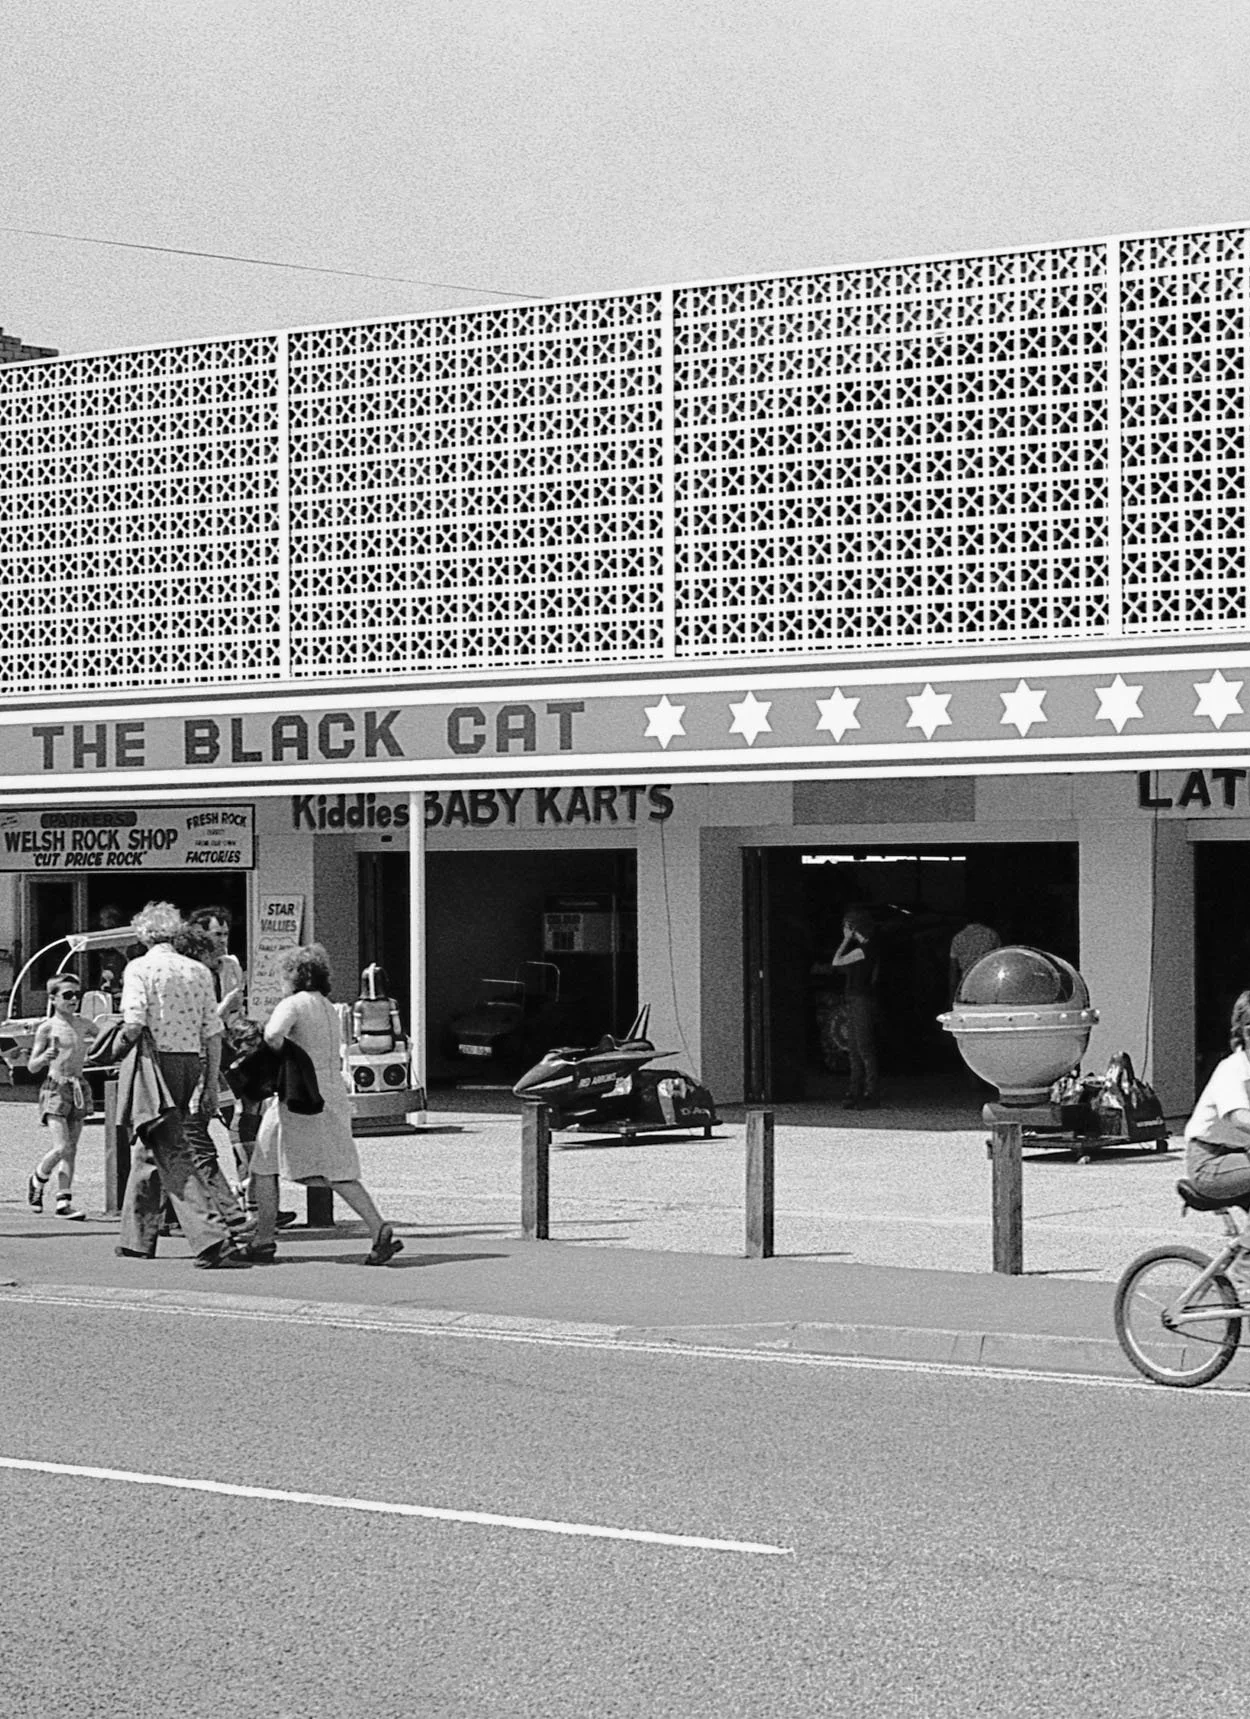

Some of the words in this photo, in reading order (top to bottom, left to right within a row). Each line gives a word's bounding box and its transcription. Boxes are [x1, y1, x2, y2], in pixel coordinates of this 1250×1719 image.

[32, 722, 146, 770] THE
[184, 709, 405, 765] BLACK
[446, 701, 586, 755] CAT
[292, 794, 410, 831] Kiddies
[424, 787, 524, 829] BABY
[533, 784, 673, 827] KARTS
[186, 812, 219, 830] FRESH
[221, 812, 247, 828] ROCK
[4, 830, 65, 853] WELSH
[71, 829, 121, 850] ROCK
[128, 828, 178, 850] SHOP
[64, 852, 103, 866] PRICE
[185, 850, 241, 864] FACTORIES
[267, 903, 295, 916] STAR
[260, 919, 297, 932] VALUES
